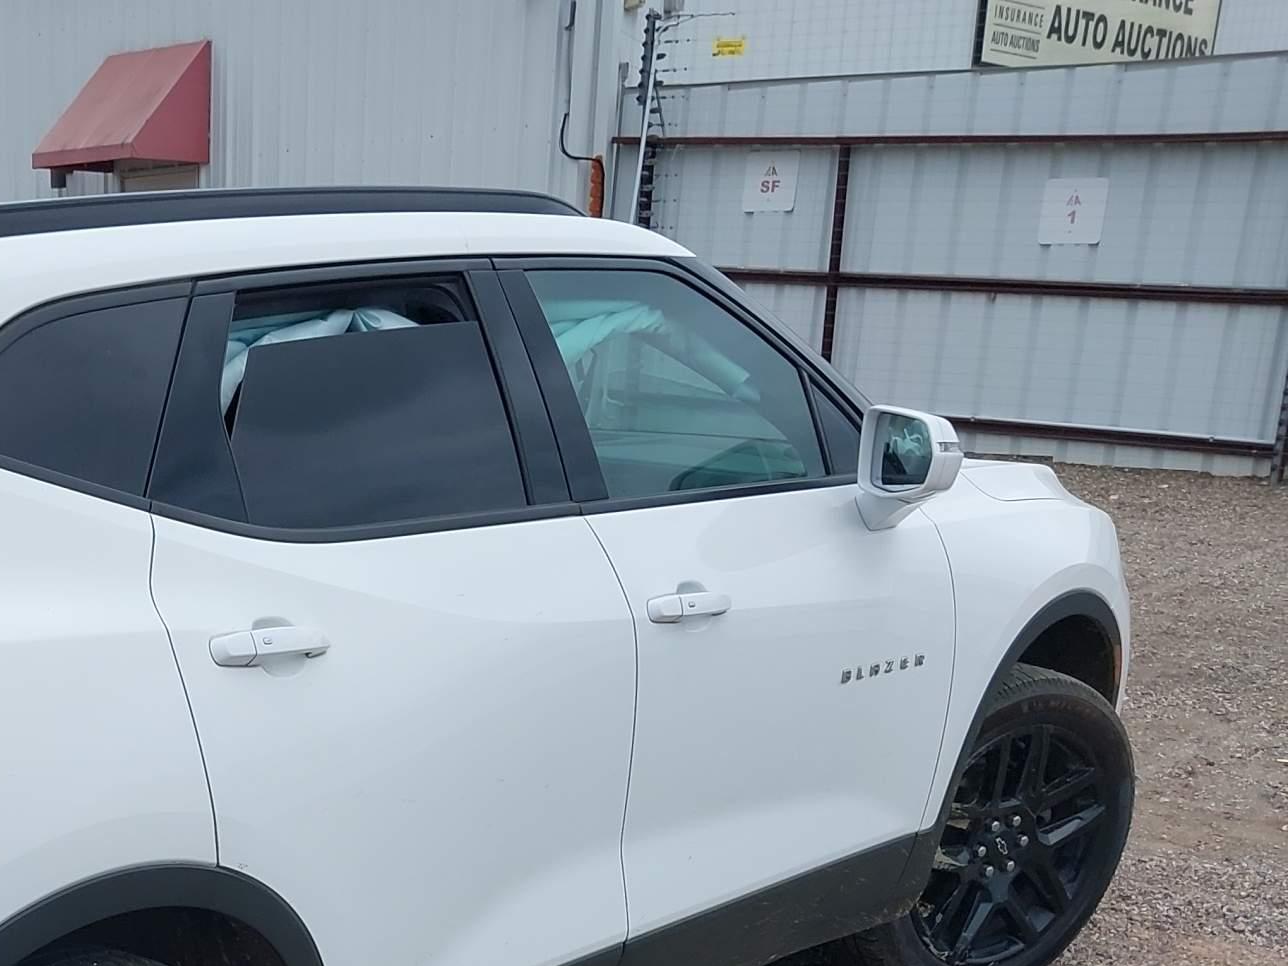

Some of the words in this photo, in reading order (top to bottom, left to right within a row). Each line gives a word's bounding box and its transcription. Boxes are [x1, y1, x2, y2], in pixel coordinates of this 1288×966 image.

[994, 4, 1044, 28] INSURANCE
[1046, 4, 1108, 50] AUTO
[991, 31, 1009, 47] AUTO
[1009, 34, 1041, 53] AUCTIONS
[760, 180, 781, 194] SF
[1067, 210, 1076, 225] 1
[840, 653, 925, 684] BLAZER
